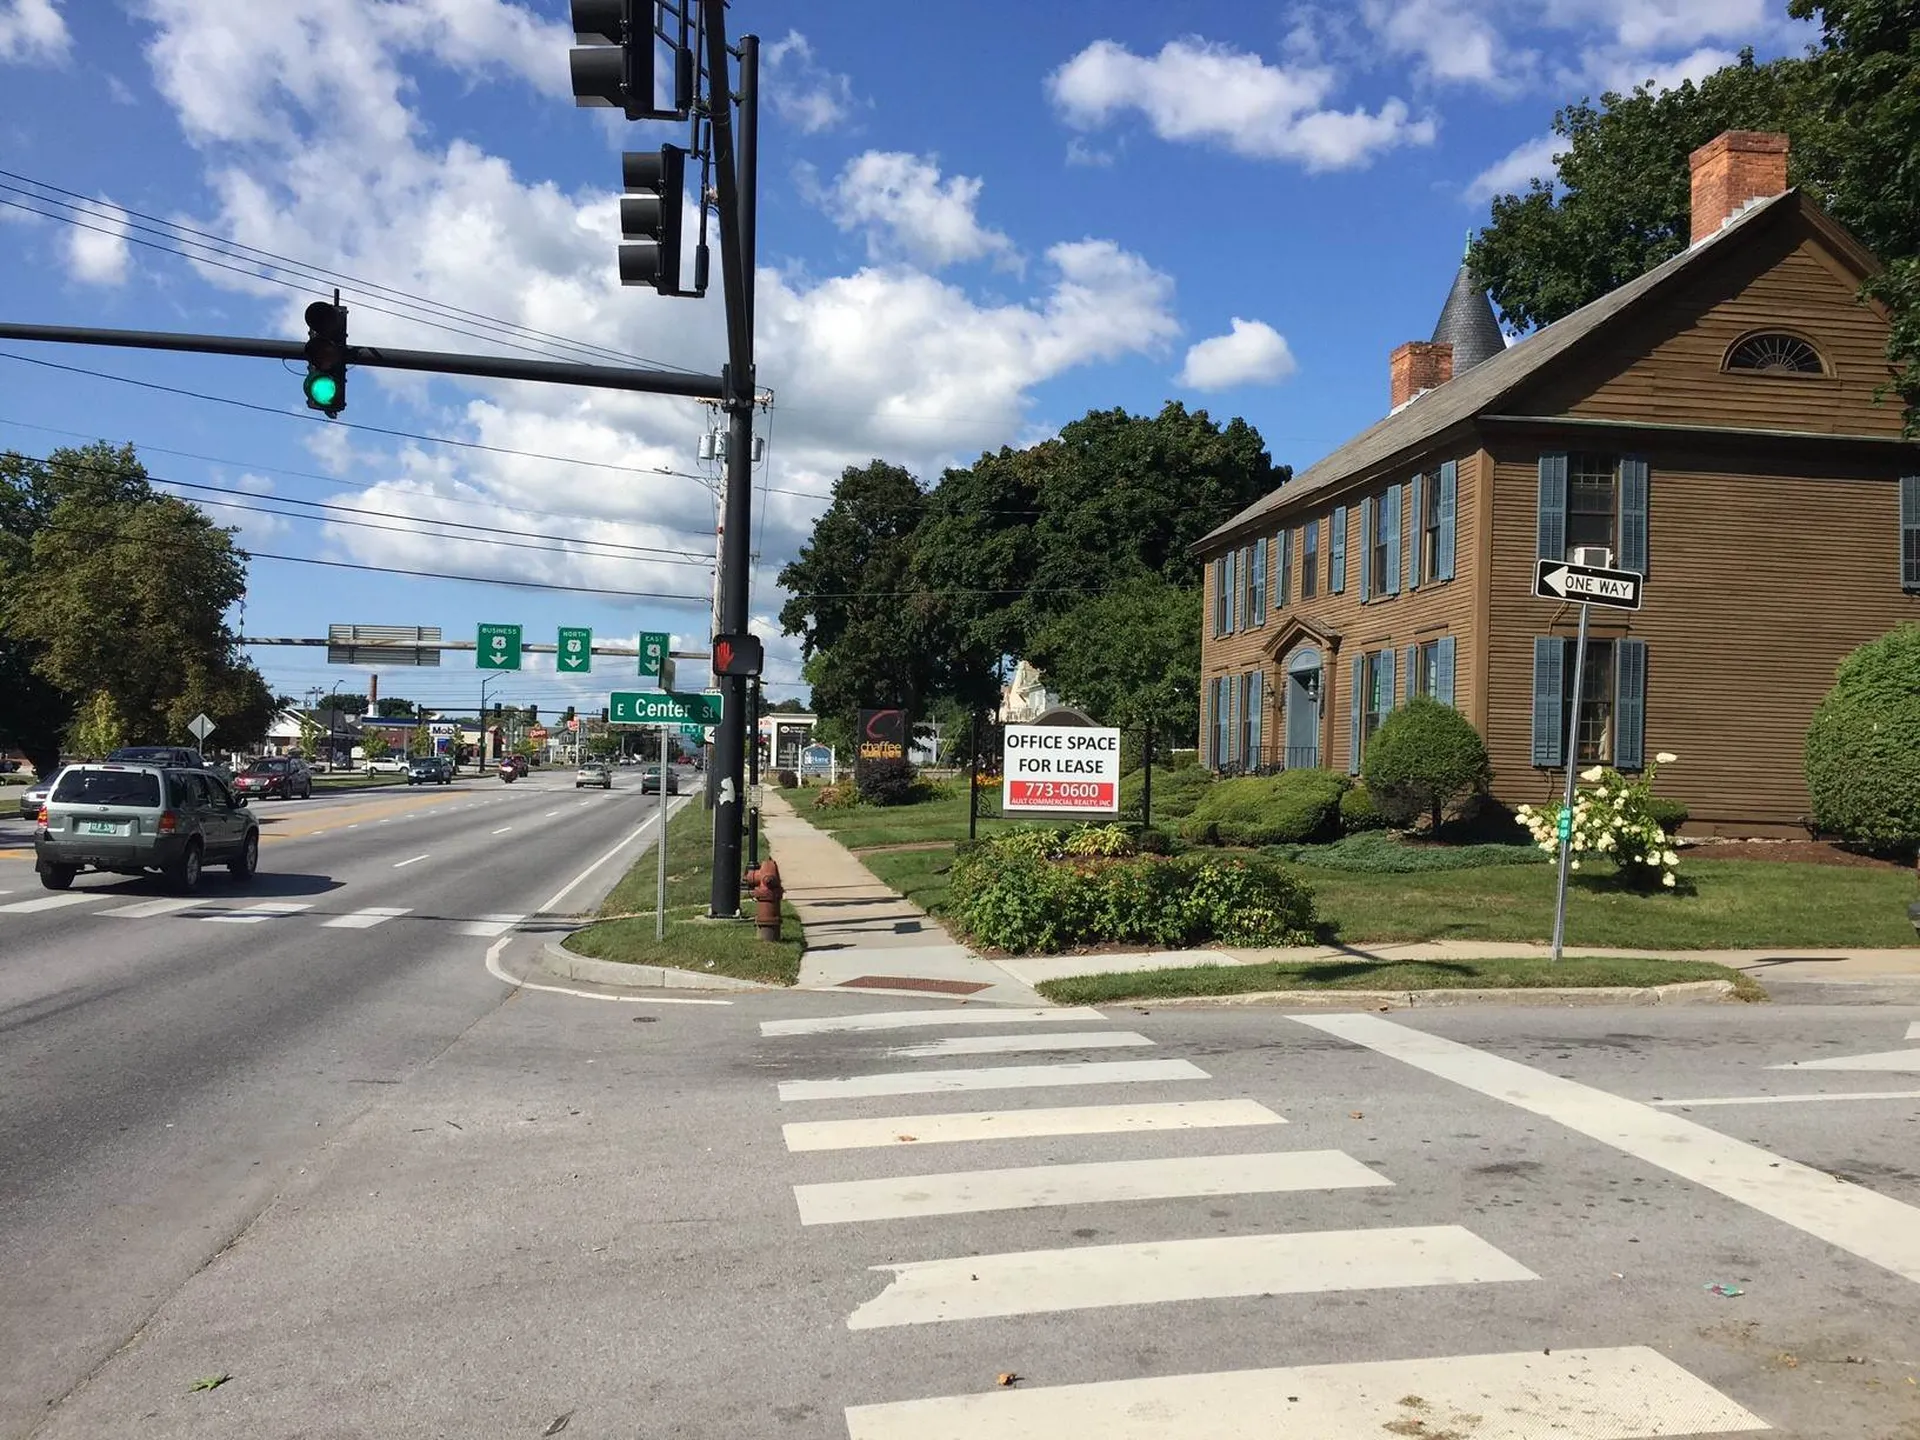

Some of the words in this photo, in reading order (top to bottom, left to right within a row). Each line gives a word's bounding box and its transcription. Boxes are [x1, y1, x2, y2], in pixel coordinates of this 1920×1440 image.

[1565, 575, 1593, 592] ONE
[1599, 579, 1629, 597] WAY
[481, 627, 517, 635] BUSINESS
[617, 703, 624, 716] E
[635, 698, 691, 718] Center
[702, 705, 714, 719] St
[432, 726, 454, 735] Mob
[860, 740, 902, 753] chaffee
[1007, 734, 1063, 749] OFFICE
[1067, 735, 1117, 751] SPACE
[1019, 758, 1051, 773] FOR
[1056, 759, 1104, 774] LEASE
[1025, 782, 1099, 798] 773-0600
[1028, 797, 1073, 806] COMMERCIAL
